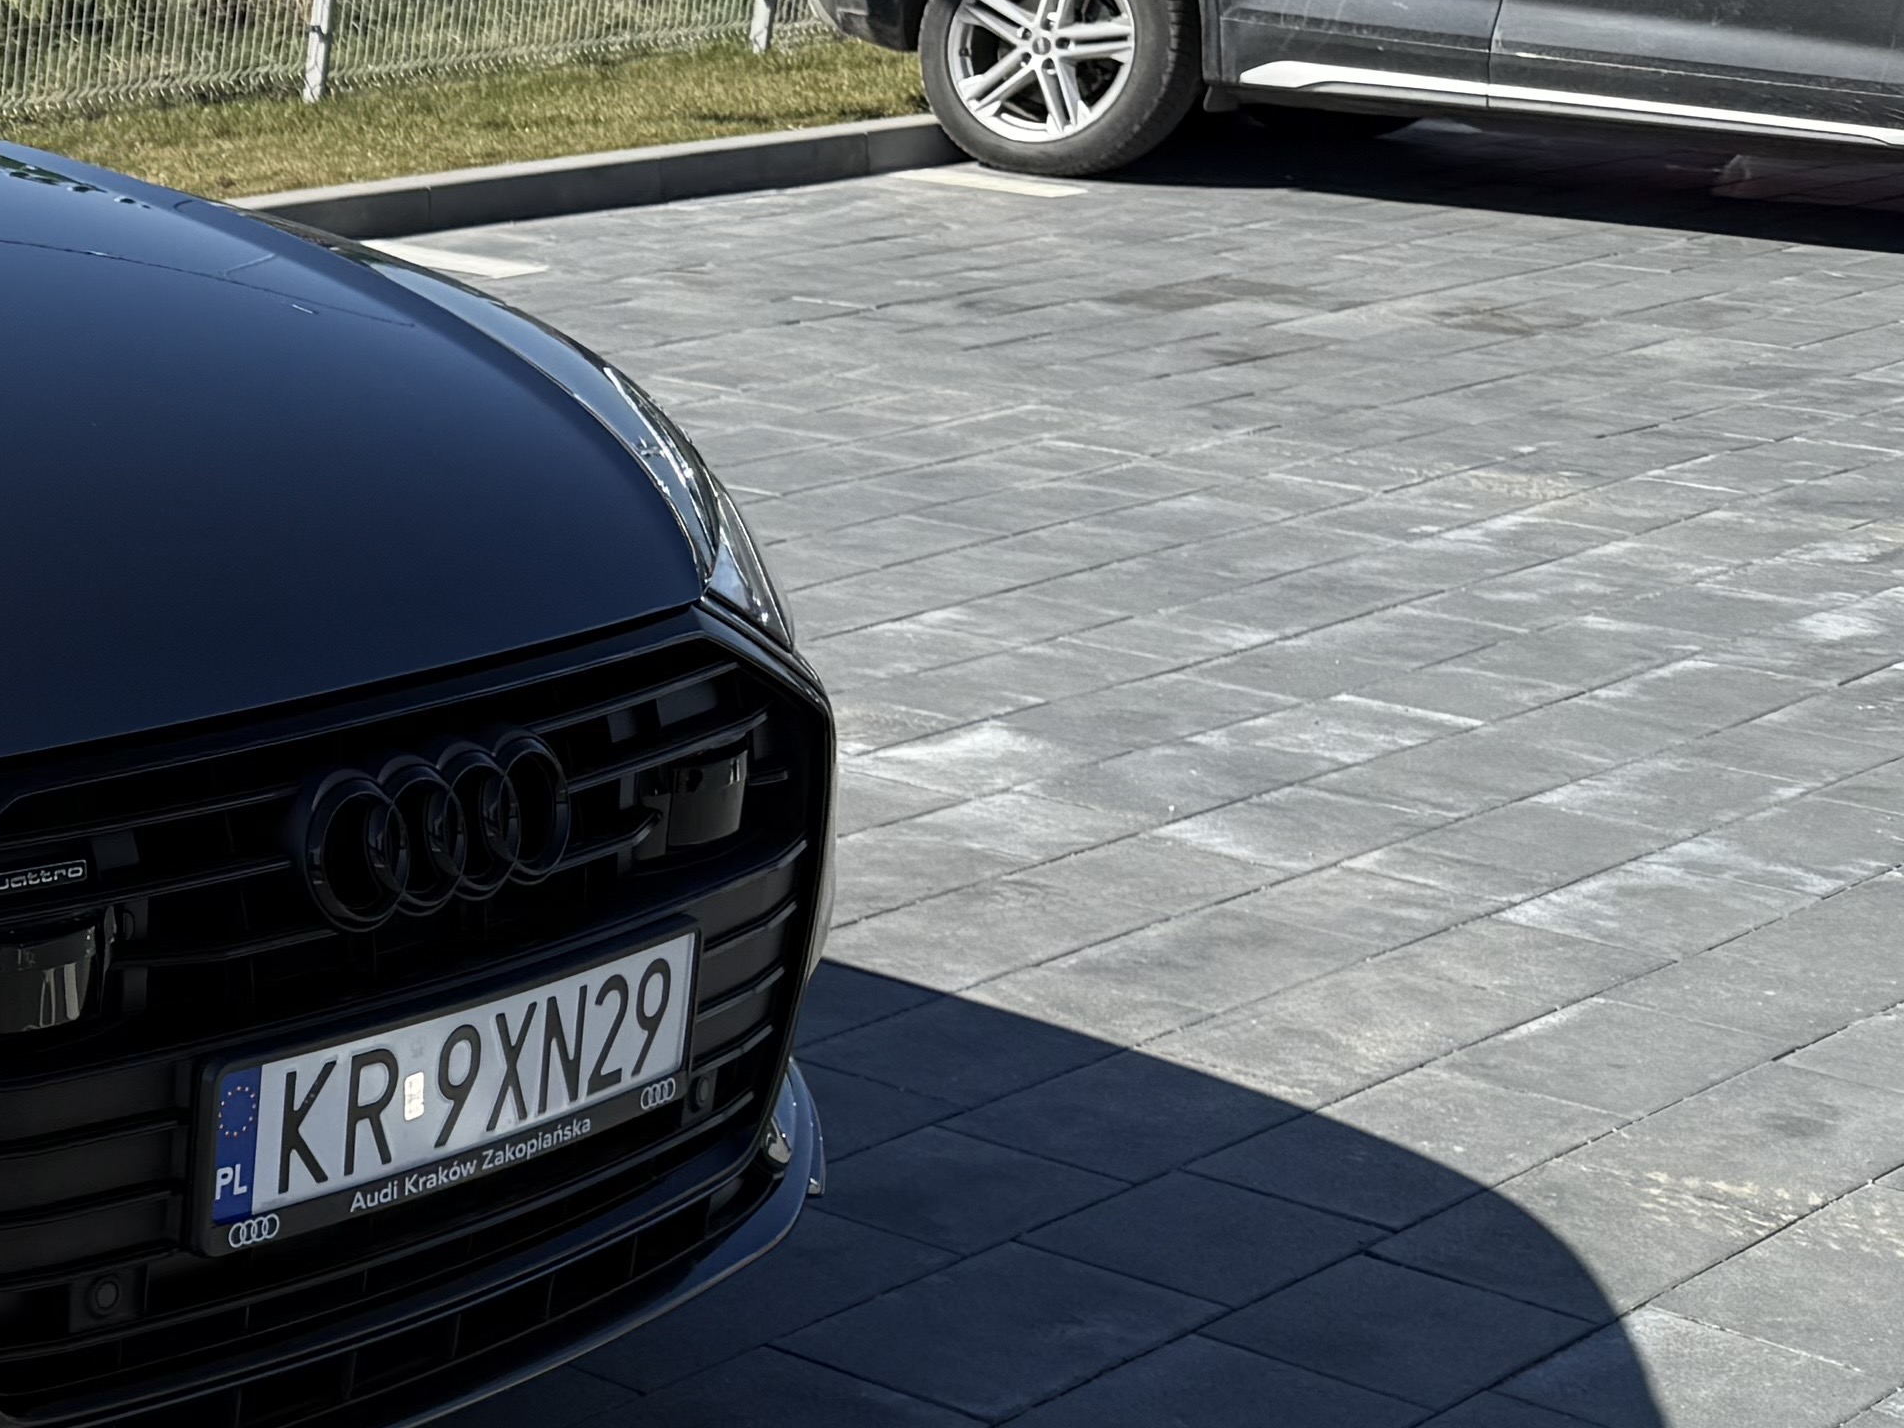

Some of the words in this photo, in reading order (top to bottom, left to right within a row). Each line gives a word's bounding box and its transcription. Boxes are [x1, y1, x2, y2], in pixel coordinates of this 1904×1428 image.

[277, 1048, 399, 1196] KR
[433, 957, 673, 1149] 9XN29
[214, 1164, 248, 1202] PL
[348, 1179, 398, 1214] Audi
[403, 1156, 478, 1197] Kraków
[481, 1117, 592, 1172] Zakopiańska
